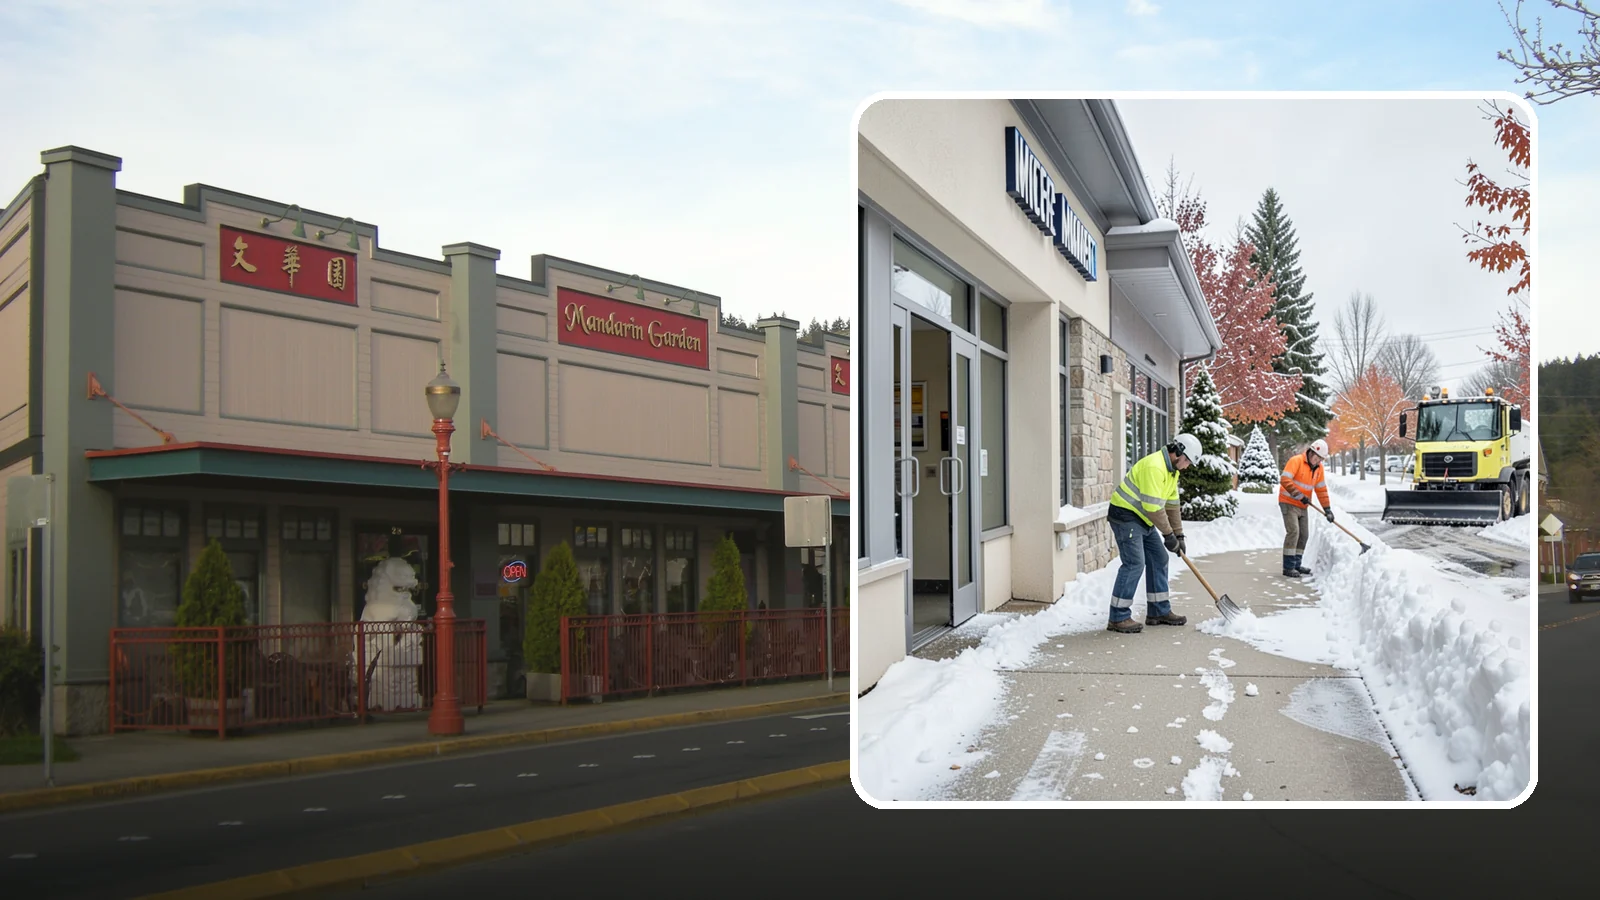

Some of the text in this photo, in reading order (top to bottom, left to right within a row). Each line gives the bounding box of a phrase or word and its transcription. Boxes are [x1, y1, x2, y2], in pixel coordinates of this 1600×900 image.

[564, 302, 702, 352] Mandarin Garden
[835, 363, 846, 386] 文
[503, 565, 527, 578] OPEN
